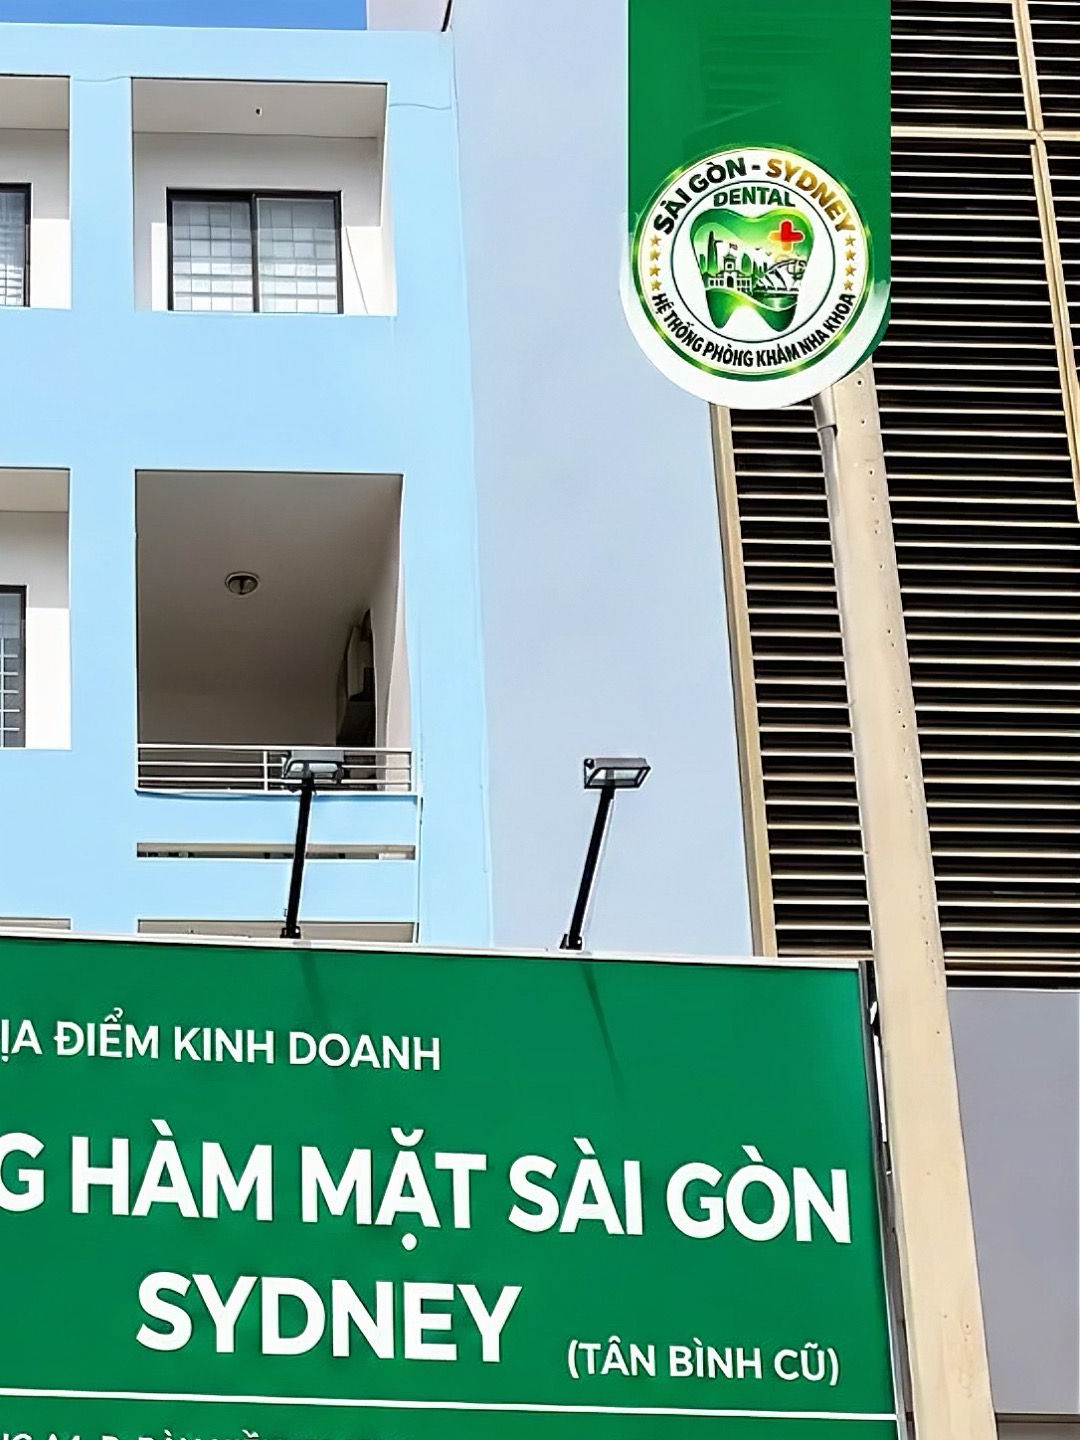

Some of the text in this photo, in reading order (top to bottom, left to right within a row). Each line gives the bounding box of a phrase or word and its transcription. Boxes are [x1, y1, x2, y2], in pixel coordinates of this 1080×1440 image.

[54, 1008, 159, 1059] ĐIỂM
[174, 1027, 274, 1064] KINH
[289, 1032, 440, 1071] DOANH
[72, 1120, 273, 1221] HÀM
[301, 1128, 487, 1251] MẶT
[508, 1138, 643, 1236] SÀI
[667, 1145, 851, 1244] GÒN
[135, 1272, 523, 1363] SYDNEY
[567, 1336, 839, 1386] (TÂN BÌNH CŨ)
